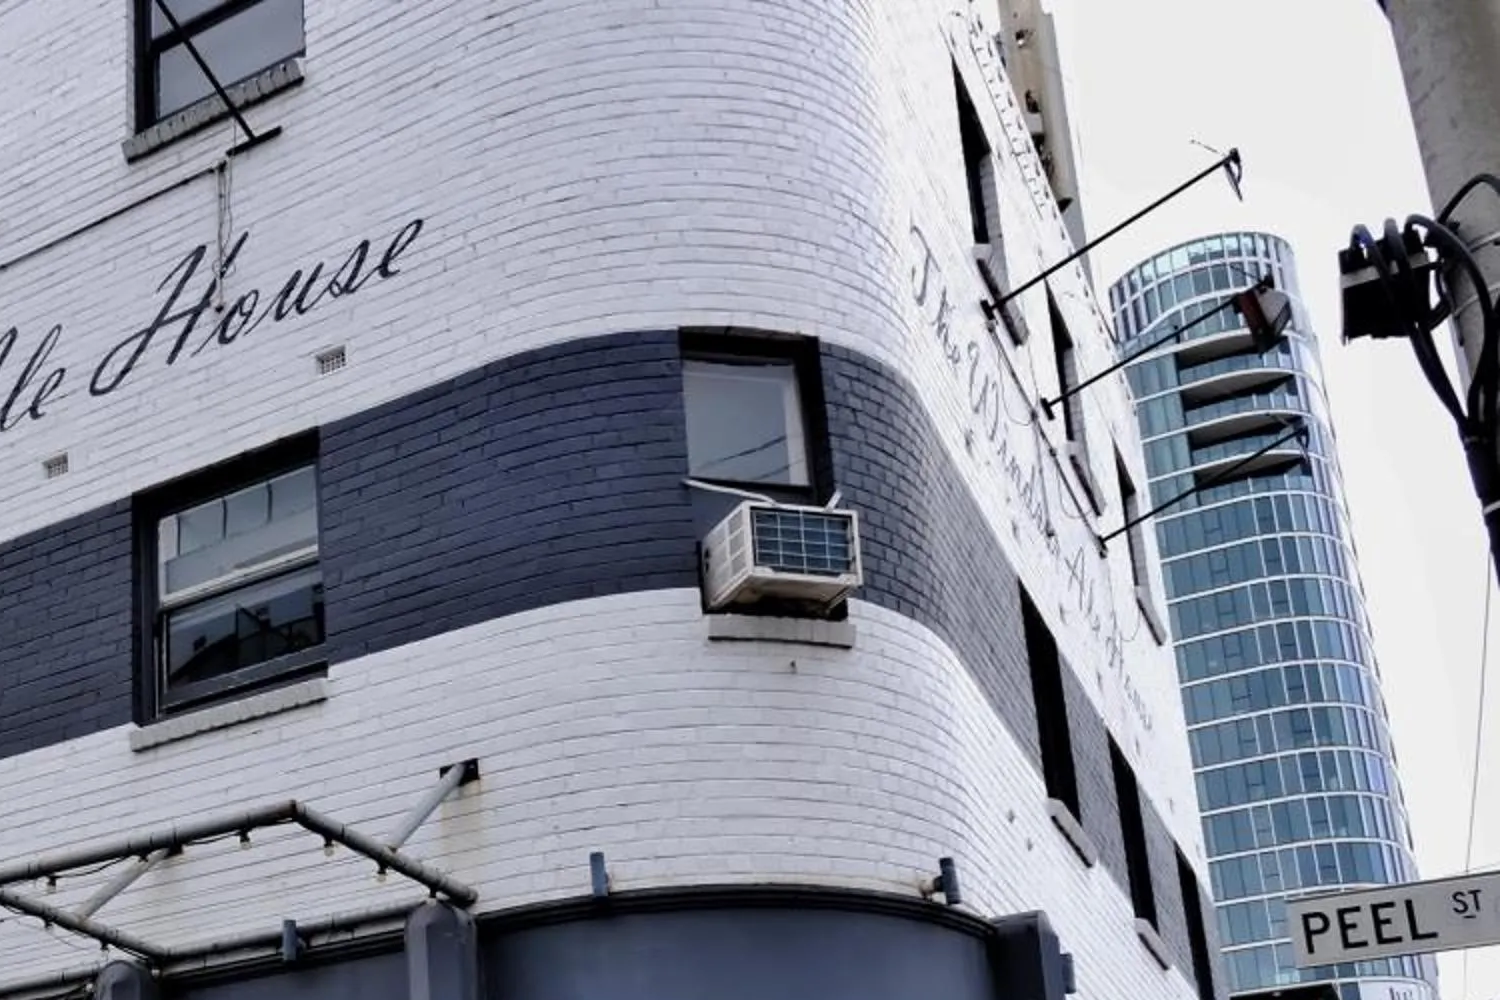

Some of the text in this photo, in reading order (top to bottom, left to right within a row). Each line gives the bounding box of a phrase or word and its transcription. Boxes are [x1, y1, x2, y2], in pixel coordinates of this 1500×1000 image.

[90, 219, 425, 397] House
[1301, 889, 1482, 955] PEEL ST
